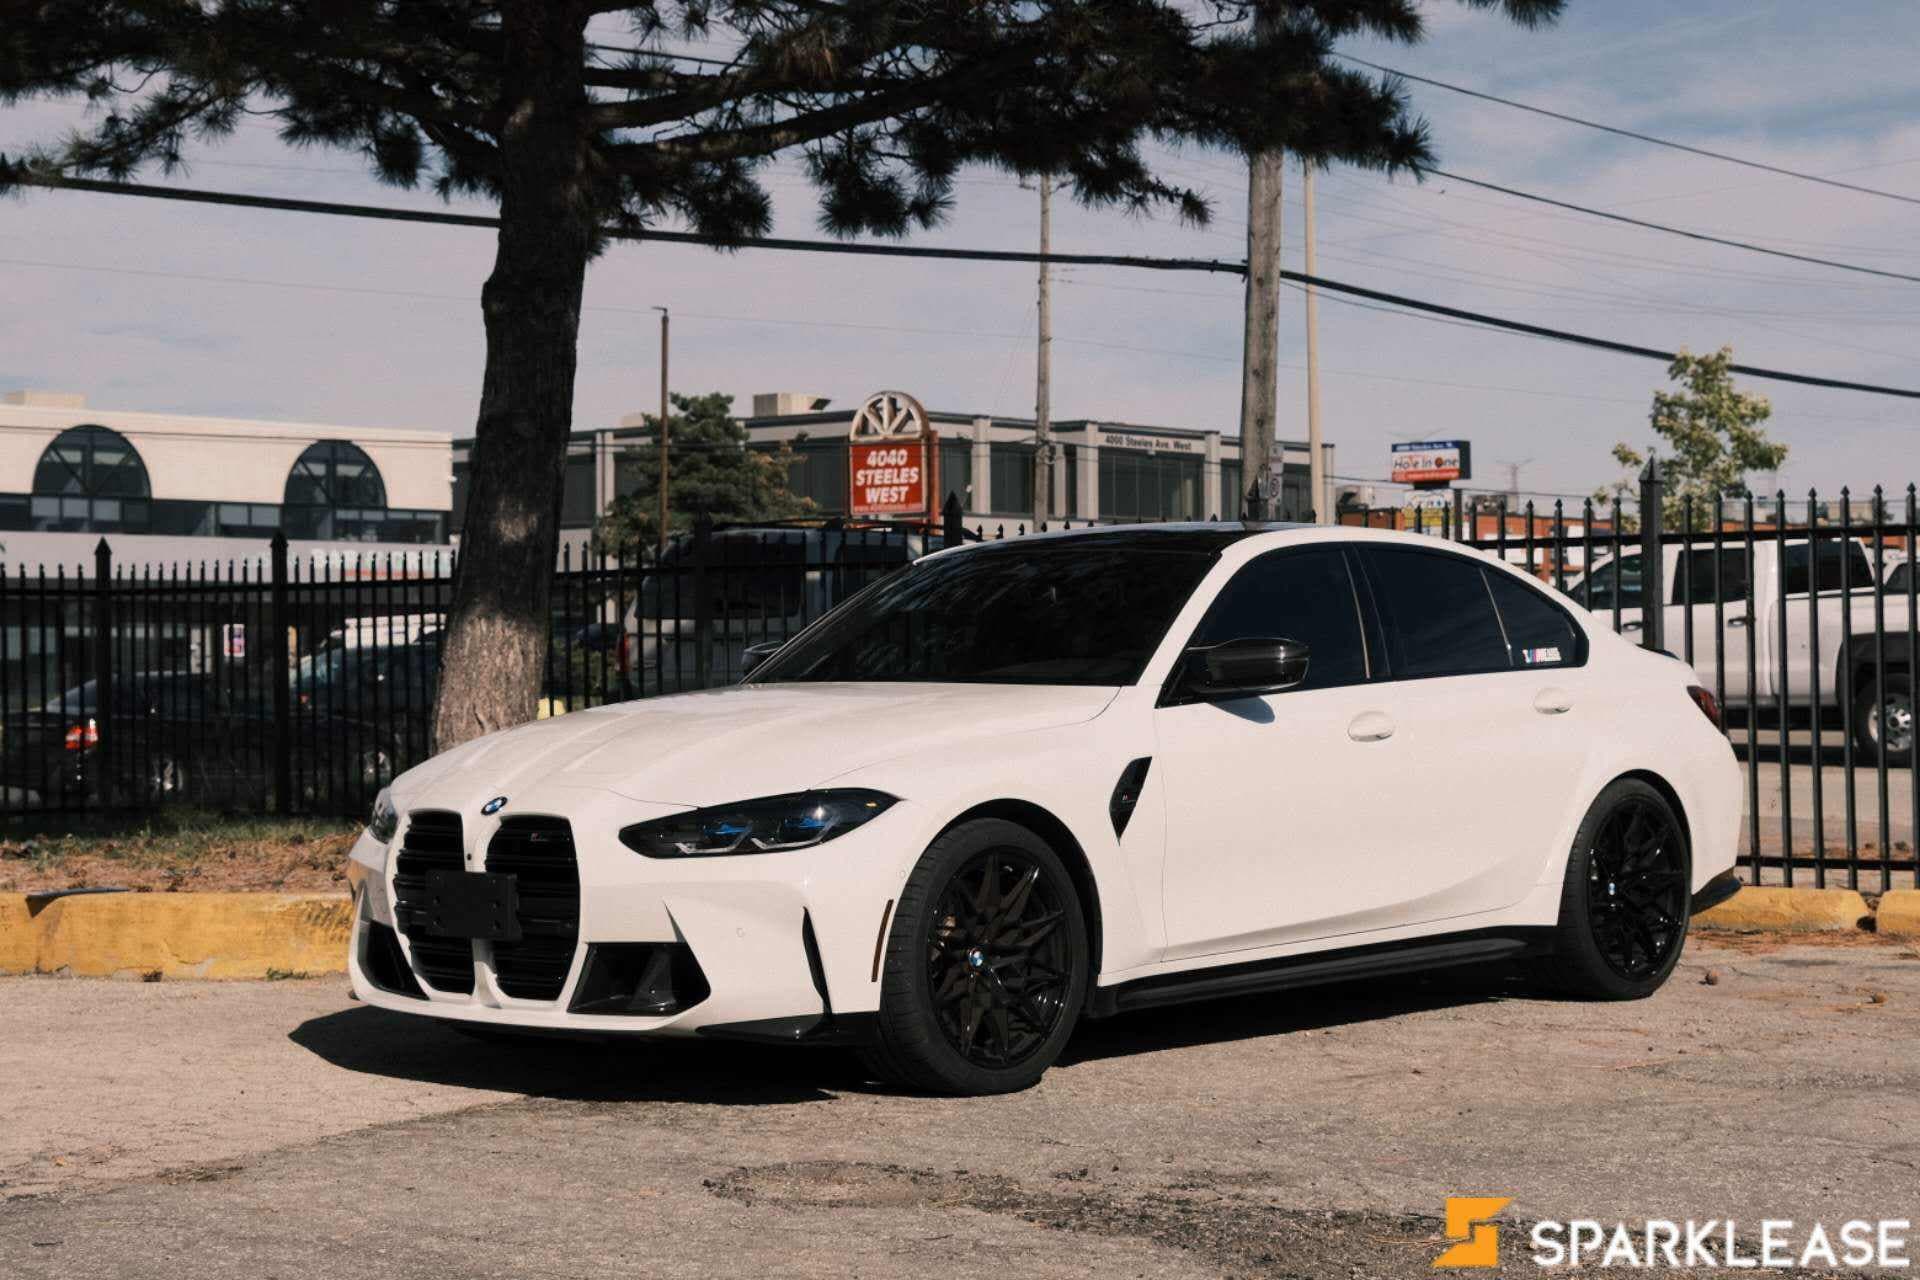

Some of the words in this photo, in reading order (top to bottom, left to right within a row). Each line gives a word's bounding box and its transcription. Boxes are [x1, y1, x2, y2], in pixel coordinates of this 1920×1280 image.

[866, 448, 909, 468] 4040
[855, 466, 919, 487] STEELES
[864, 485, 909, 505] WEST
